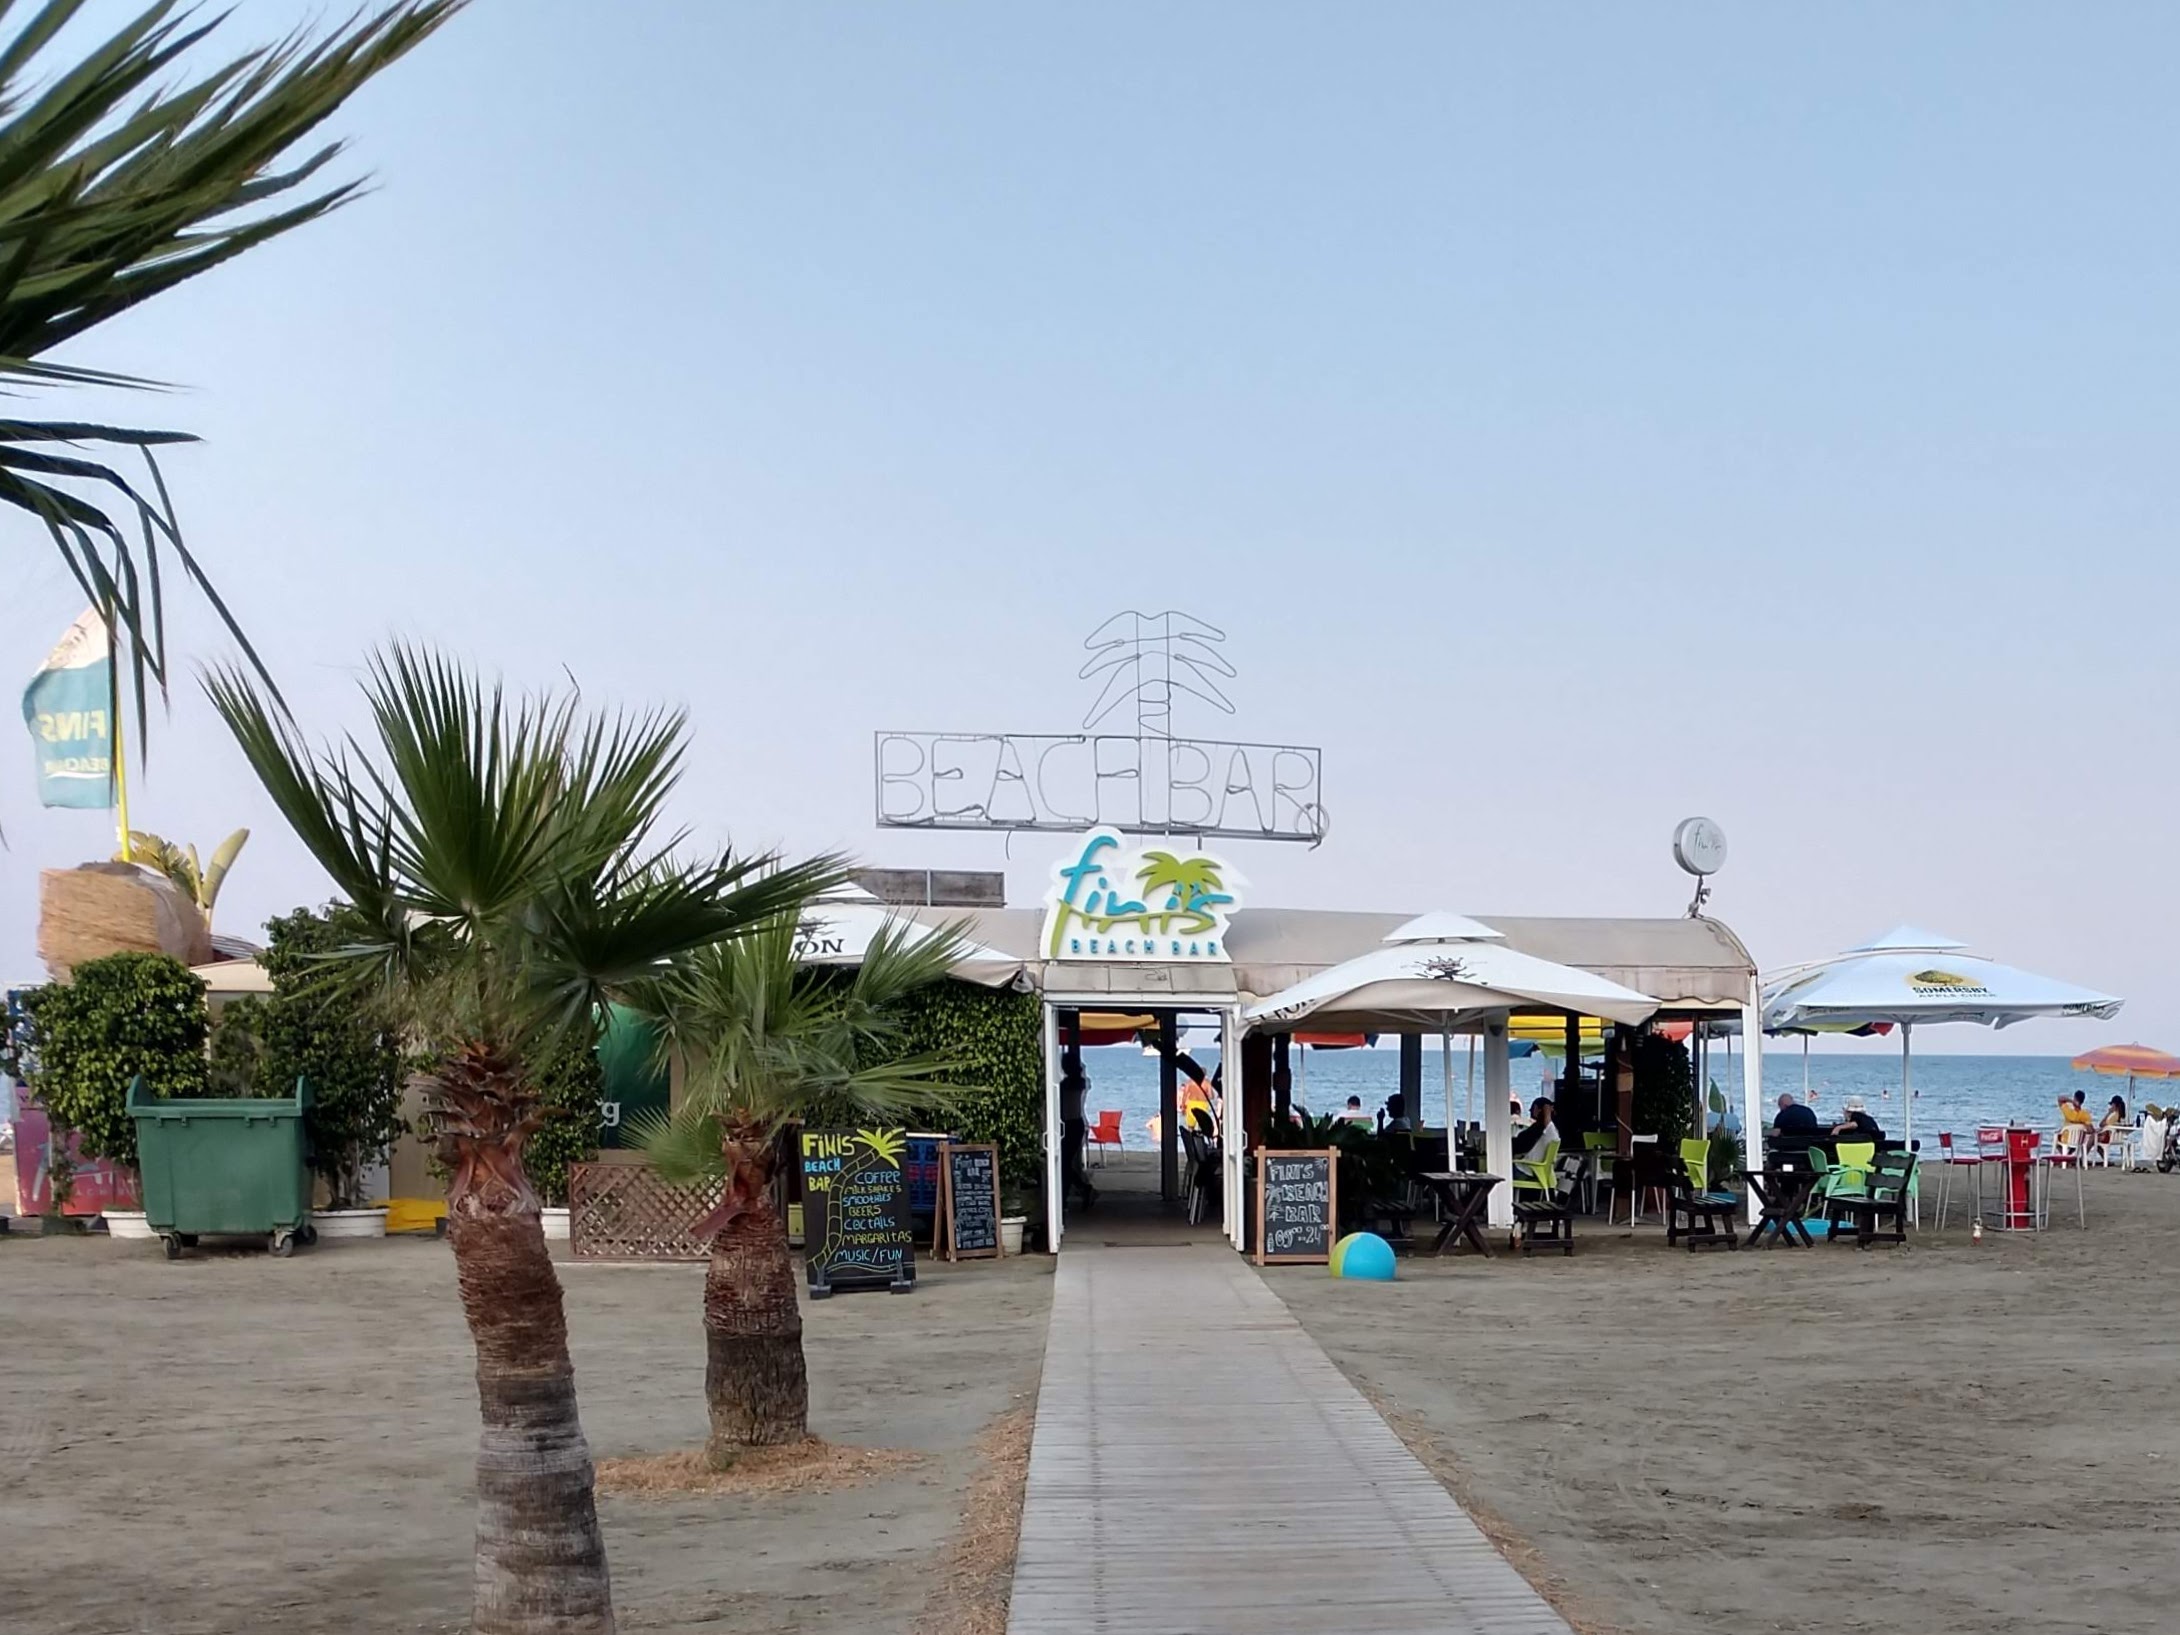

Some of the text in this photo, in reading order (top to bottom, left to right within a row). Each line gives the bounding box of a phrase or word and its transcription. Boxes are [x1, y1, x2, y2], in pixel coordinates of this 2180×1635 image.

[879, 735, 1319, 835] BEACH BAR
[793, 938, 844, 956] ON
[1070, 938, 1218, 956] BEACH BAR
[804, 1158, 841, 1173] BEACH
[808, 1176, 831, 1192] BAR
[848, 1204, 882, 1217] BEERS
[1285, 1204, 1322, 1223] BAR
